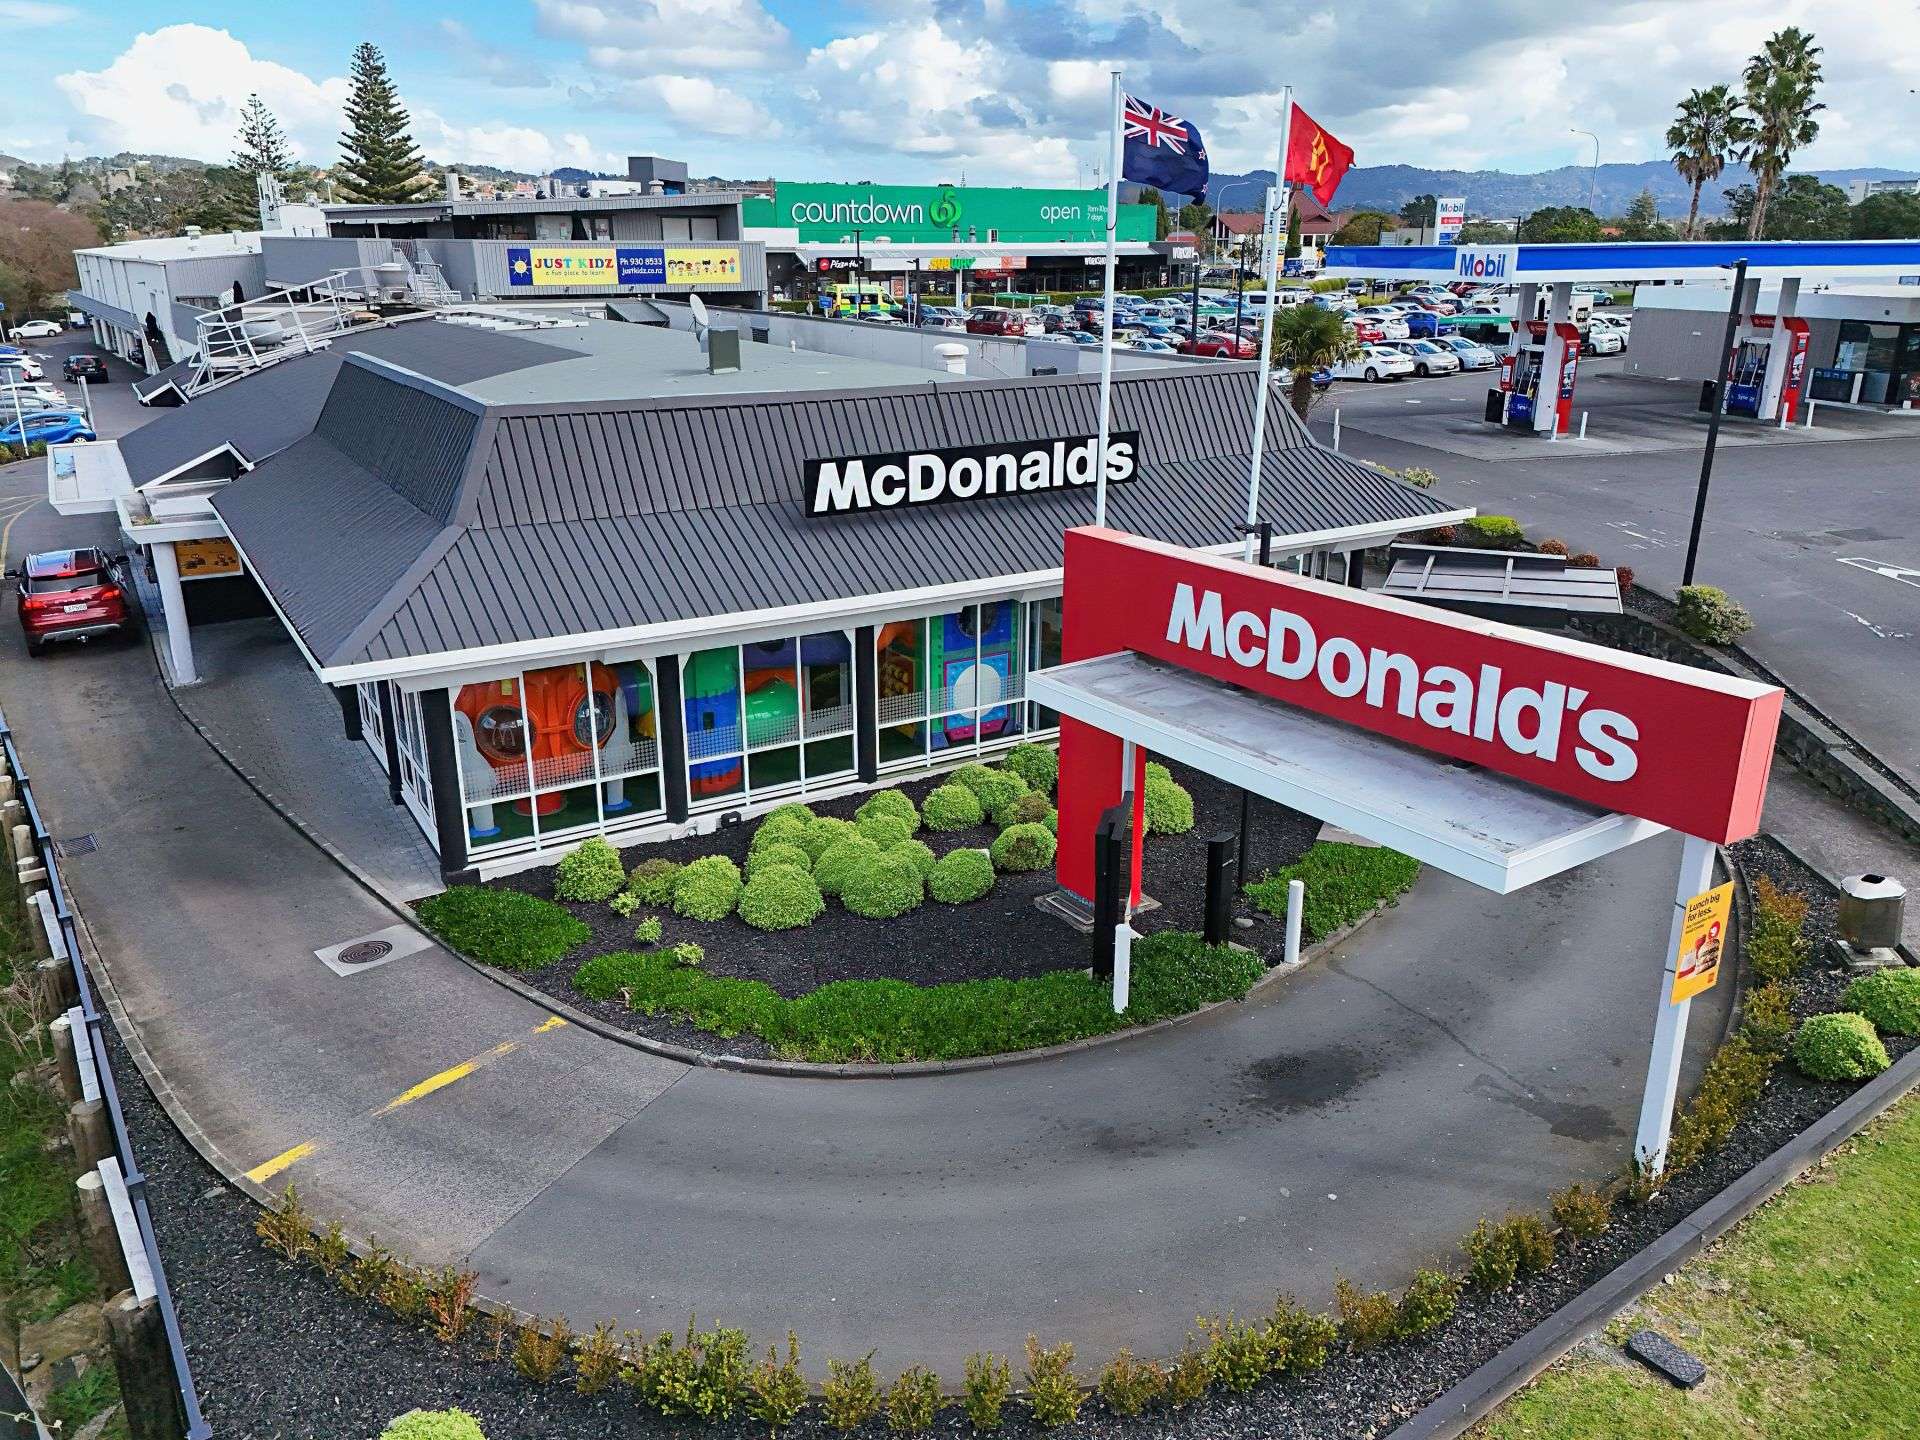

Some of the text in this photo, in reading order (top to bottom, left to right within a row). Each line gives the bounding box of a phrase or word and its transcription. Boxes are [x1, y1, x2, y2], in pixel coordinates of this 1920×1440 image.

[791, 194, 924, 224] countdown
[1040, 206, 1080, 224] open
[1440, 203, 1464, 213] Mobil
[534, 258, 614, 269] JUST KIDZ
[619, 257, 663, 266] Ph 930 8533
[830, 259, 849, 269] Pizza
[1459, 253, 1506, 277] Mobil
[813, 436, 1134, 513] McDonalds
[1165, 582, 1640, 782] McDonald's
[1689, 893, 1721, 913] Lunch big
[1687, 912, 1698, 923] for
